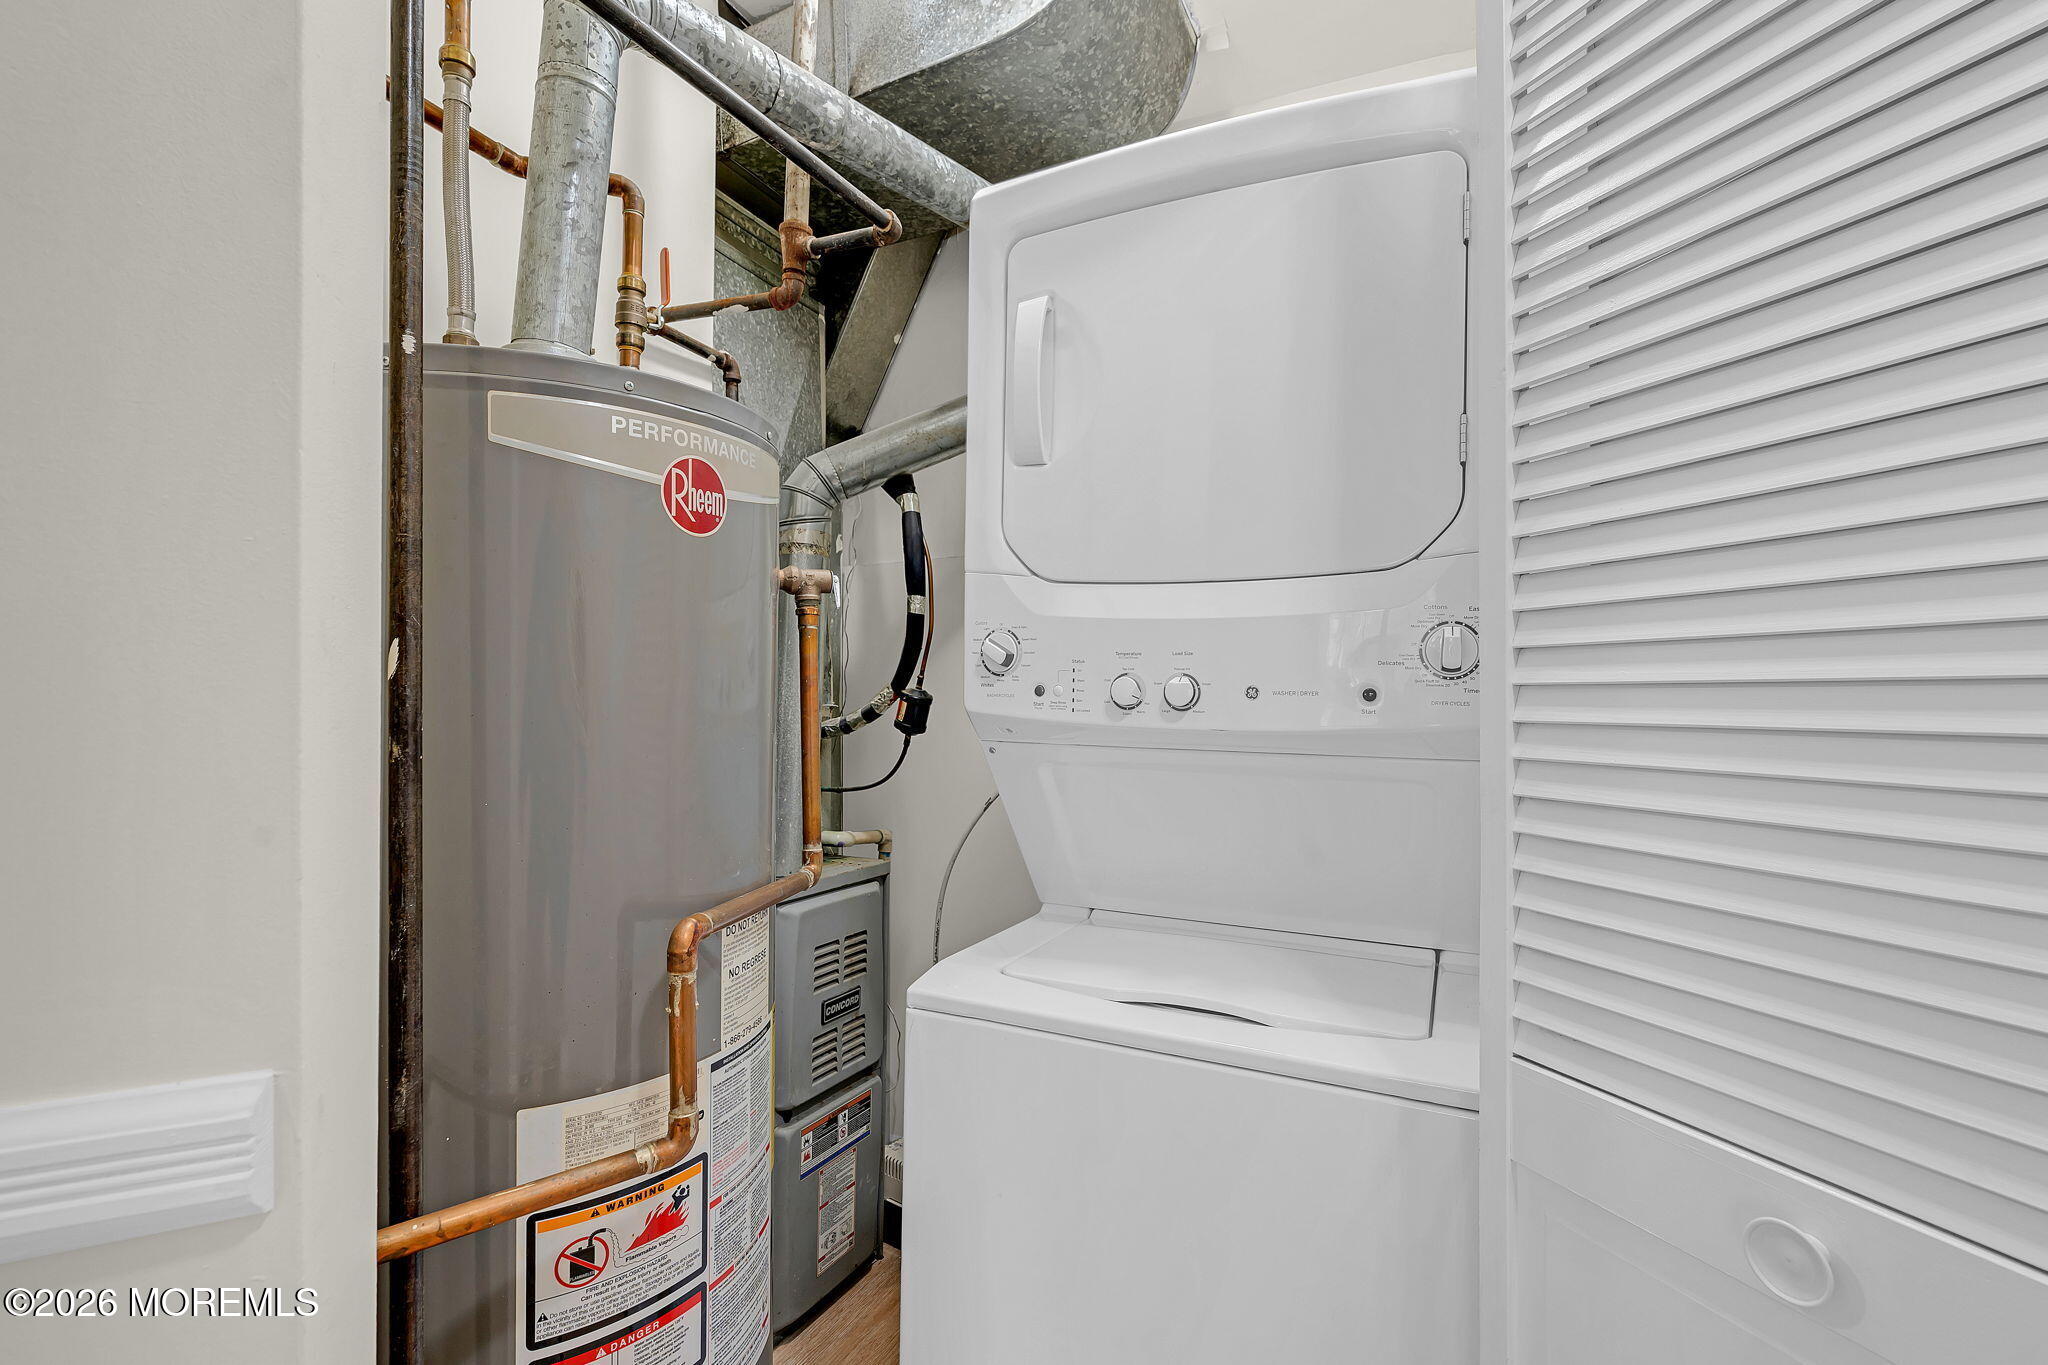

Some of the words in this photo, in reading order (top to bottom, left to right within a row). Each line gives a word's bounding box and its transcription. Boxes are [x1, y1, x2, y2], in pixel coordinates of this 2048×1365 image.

[611, 415, 756, 469] PERFORMANCE
[672, 458, 723, 522] Rheem
[726, 925, 736, 936] DO
[738, 918, 750, 932] NOT
[729, 965, 740, 979] NO
[742, 947, 766, 972] REGRESE
[826, 995, 859, 1016] CONCORD
[606, 1184, 665, 1212] WARNING
[626, 1245, 657, 1262] Flammable
[659, 1235, 677, 1247] Vapors
[586, 1285, 599, 1294] FIRE
[601, 1280, 613, 1288] AND
[615, 1265, 646, 1283] EXPLOSION
[647, 1255, 667, 1268] HAZARD
[594, 1288, 609, 1297] result
[617, 1277, 636, 1288] serious
[638, 1270, 650, 1280] injury
[569, 1305, 582, 1313] store
[610, 1320, 660, 1352] DANGER
